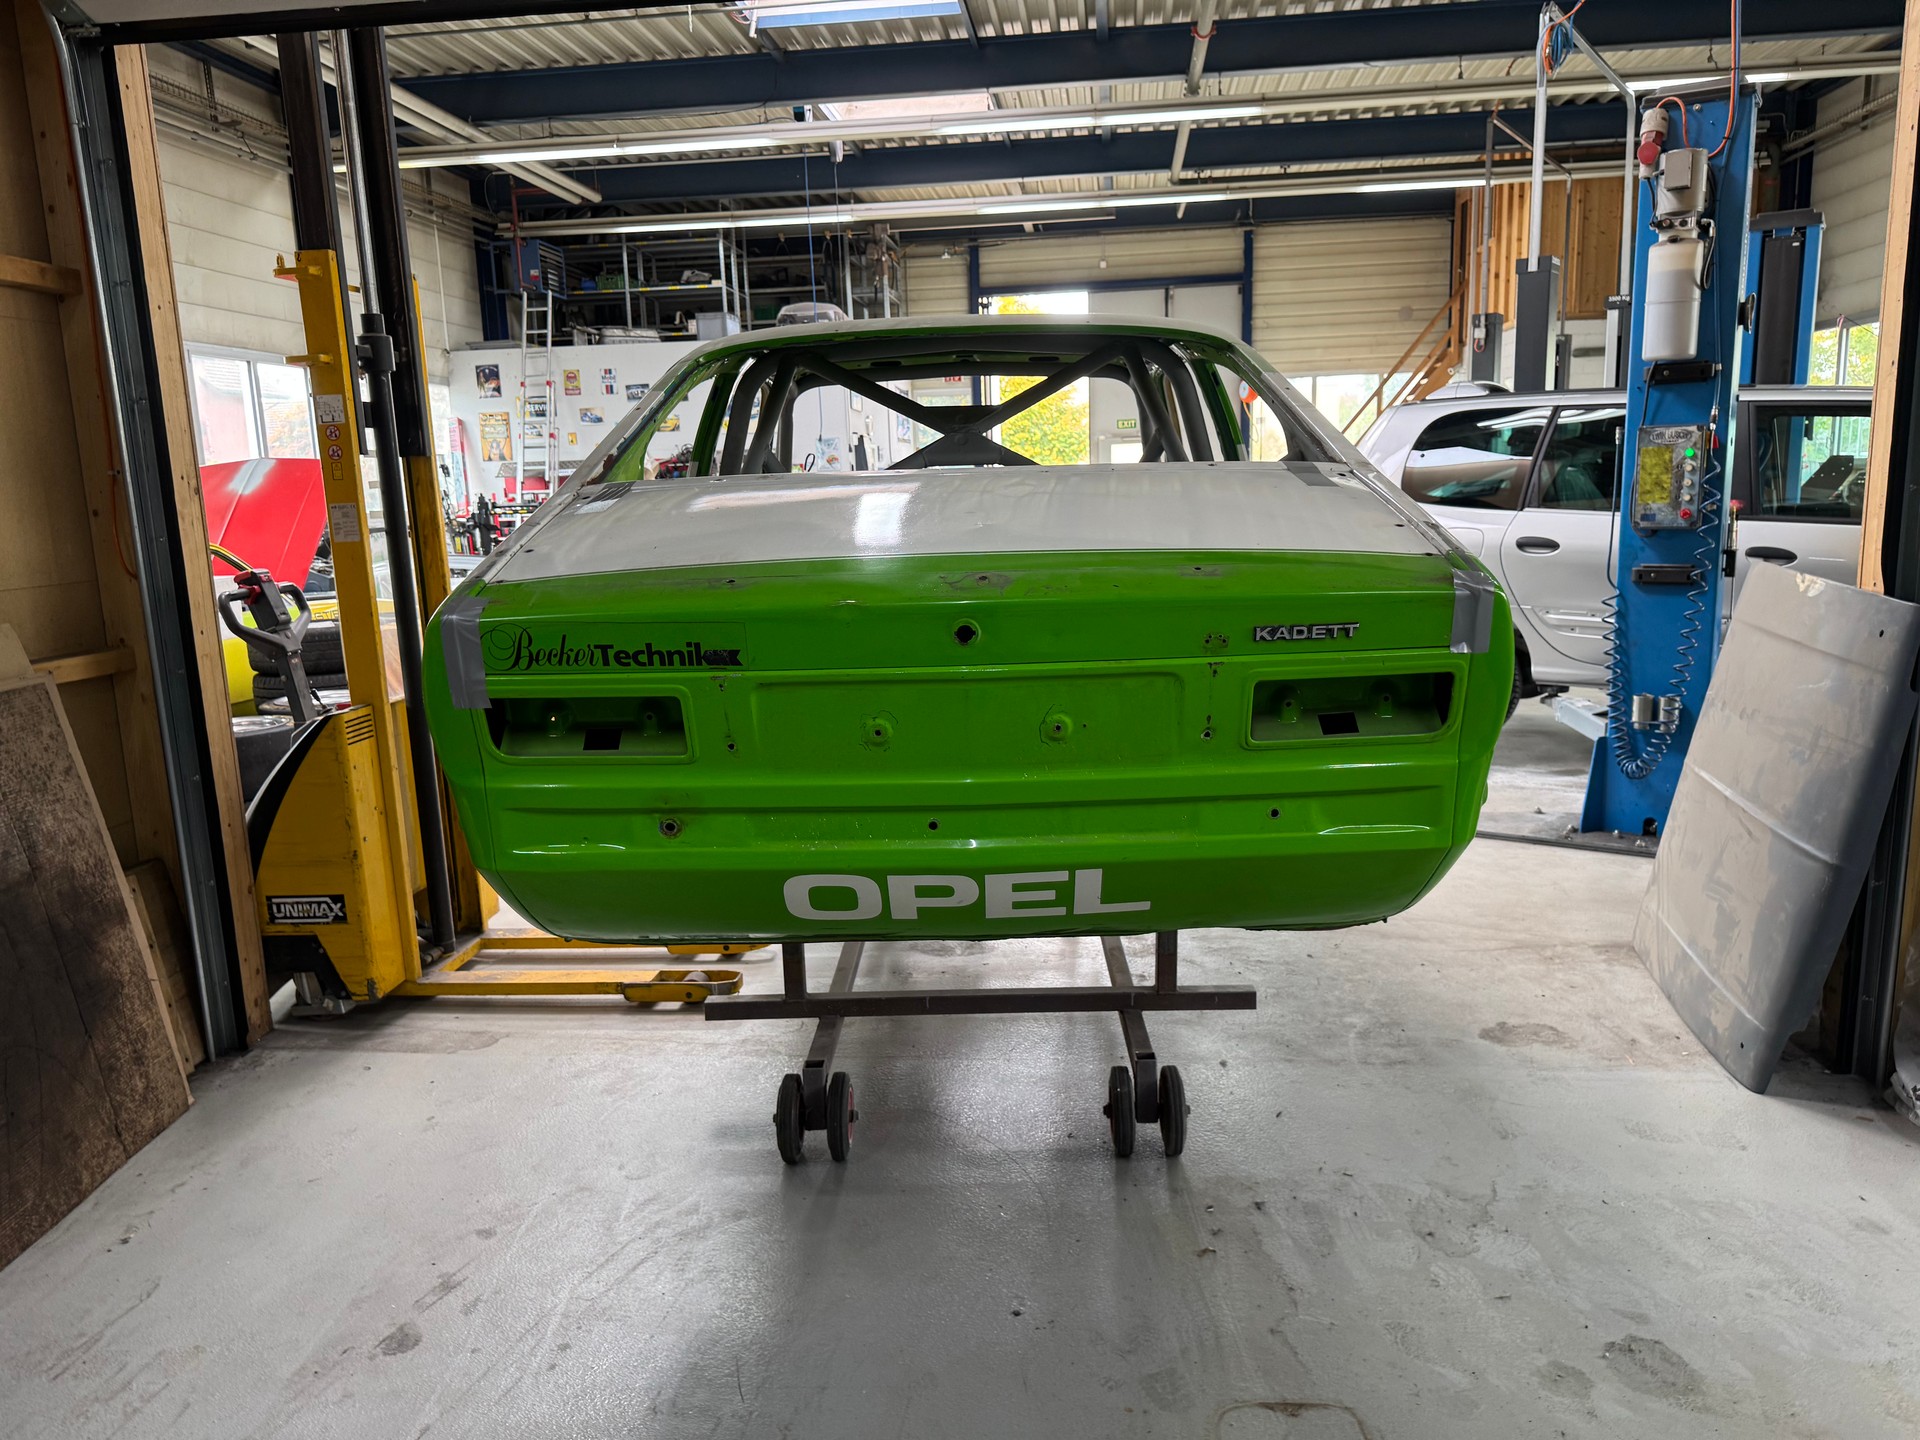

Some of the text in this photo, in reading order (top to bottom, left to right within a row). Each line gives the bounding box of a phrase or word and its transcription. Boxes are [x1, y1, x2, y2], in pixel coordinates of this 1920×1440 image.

[1118, 420, 1136, 429] EXIT
[1255, 622, 1360, 642] KADETT
[783, 868, 1151, 920] OPEL
[272, 902, 344, 918] UNIMAX
